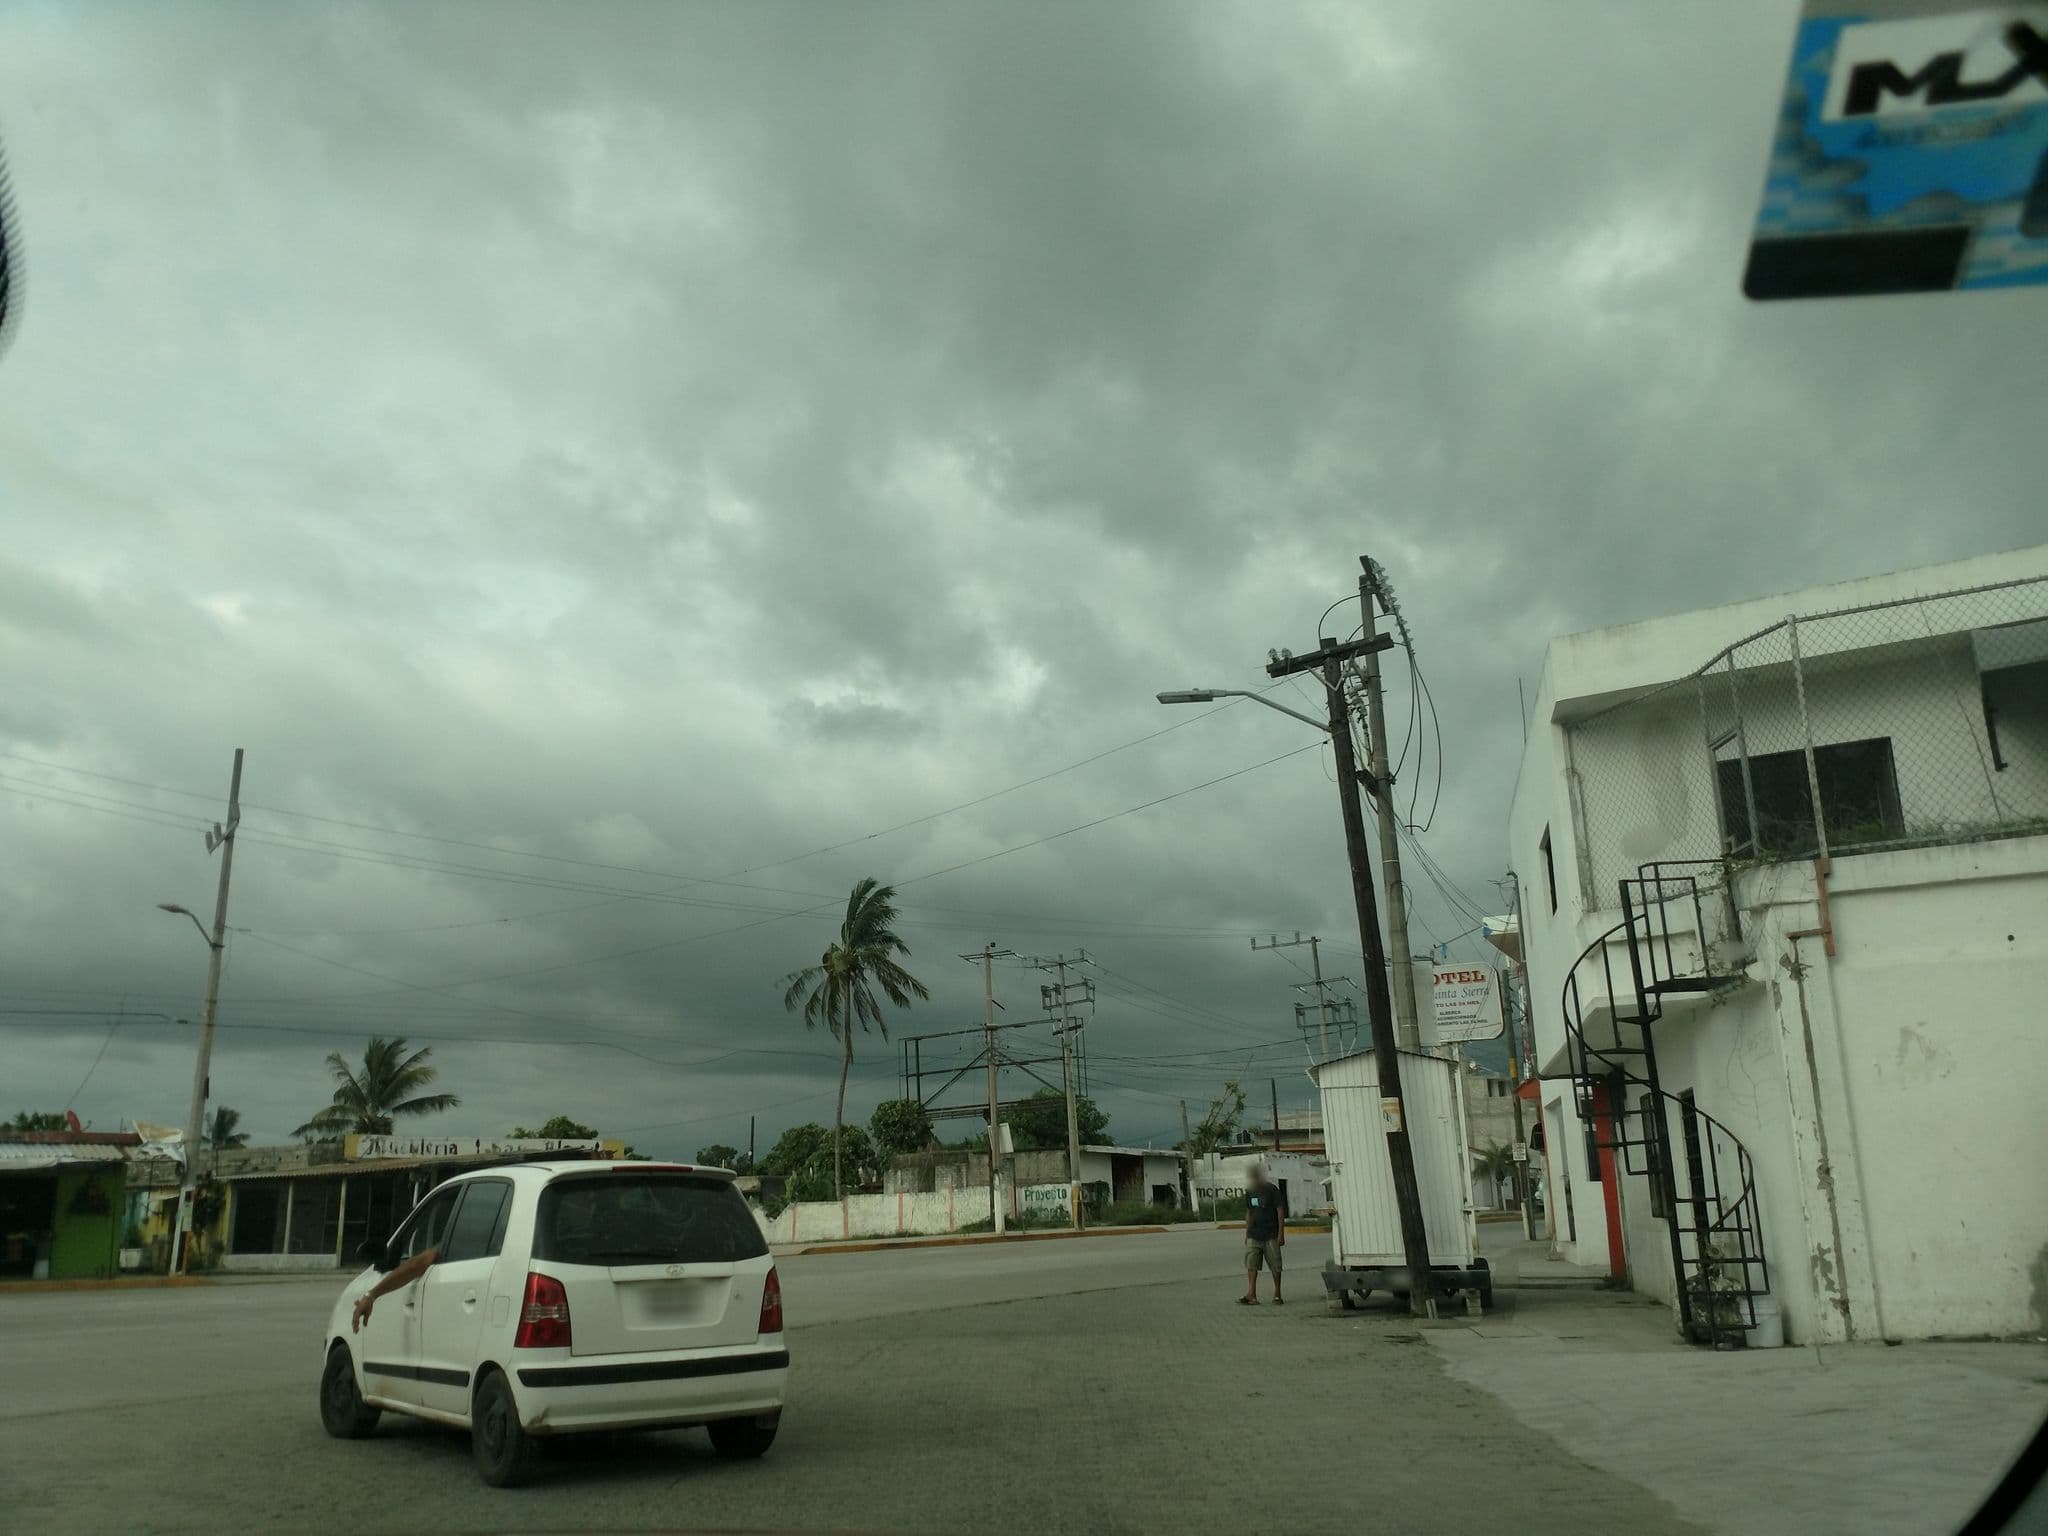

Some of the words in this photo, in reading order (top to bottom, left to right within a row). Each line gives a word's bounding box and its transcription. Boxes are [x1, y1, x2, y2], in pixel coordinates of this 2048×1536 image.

[1461, 987, 1489, 998] Sierra
[1024, 1188, 1067, 1202] Proyecto
[1196, 1187, 1245, 1199] moren
